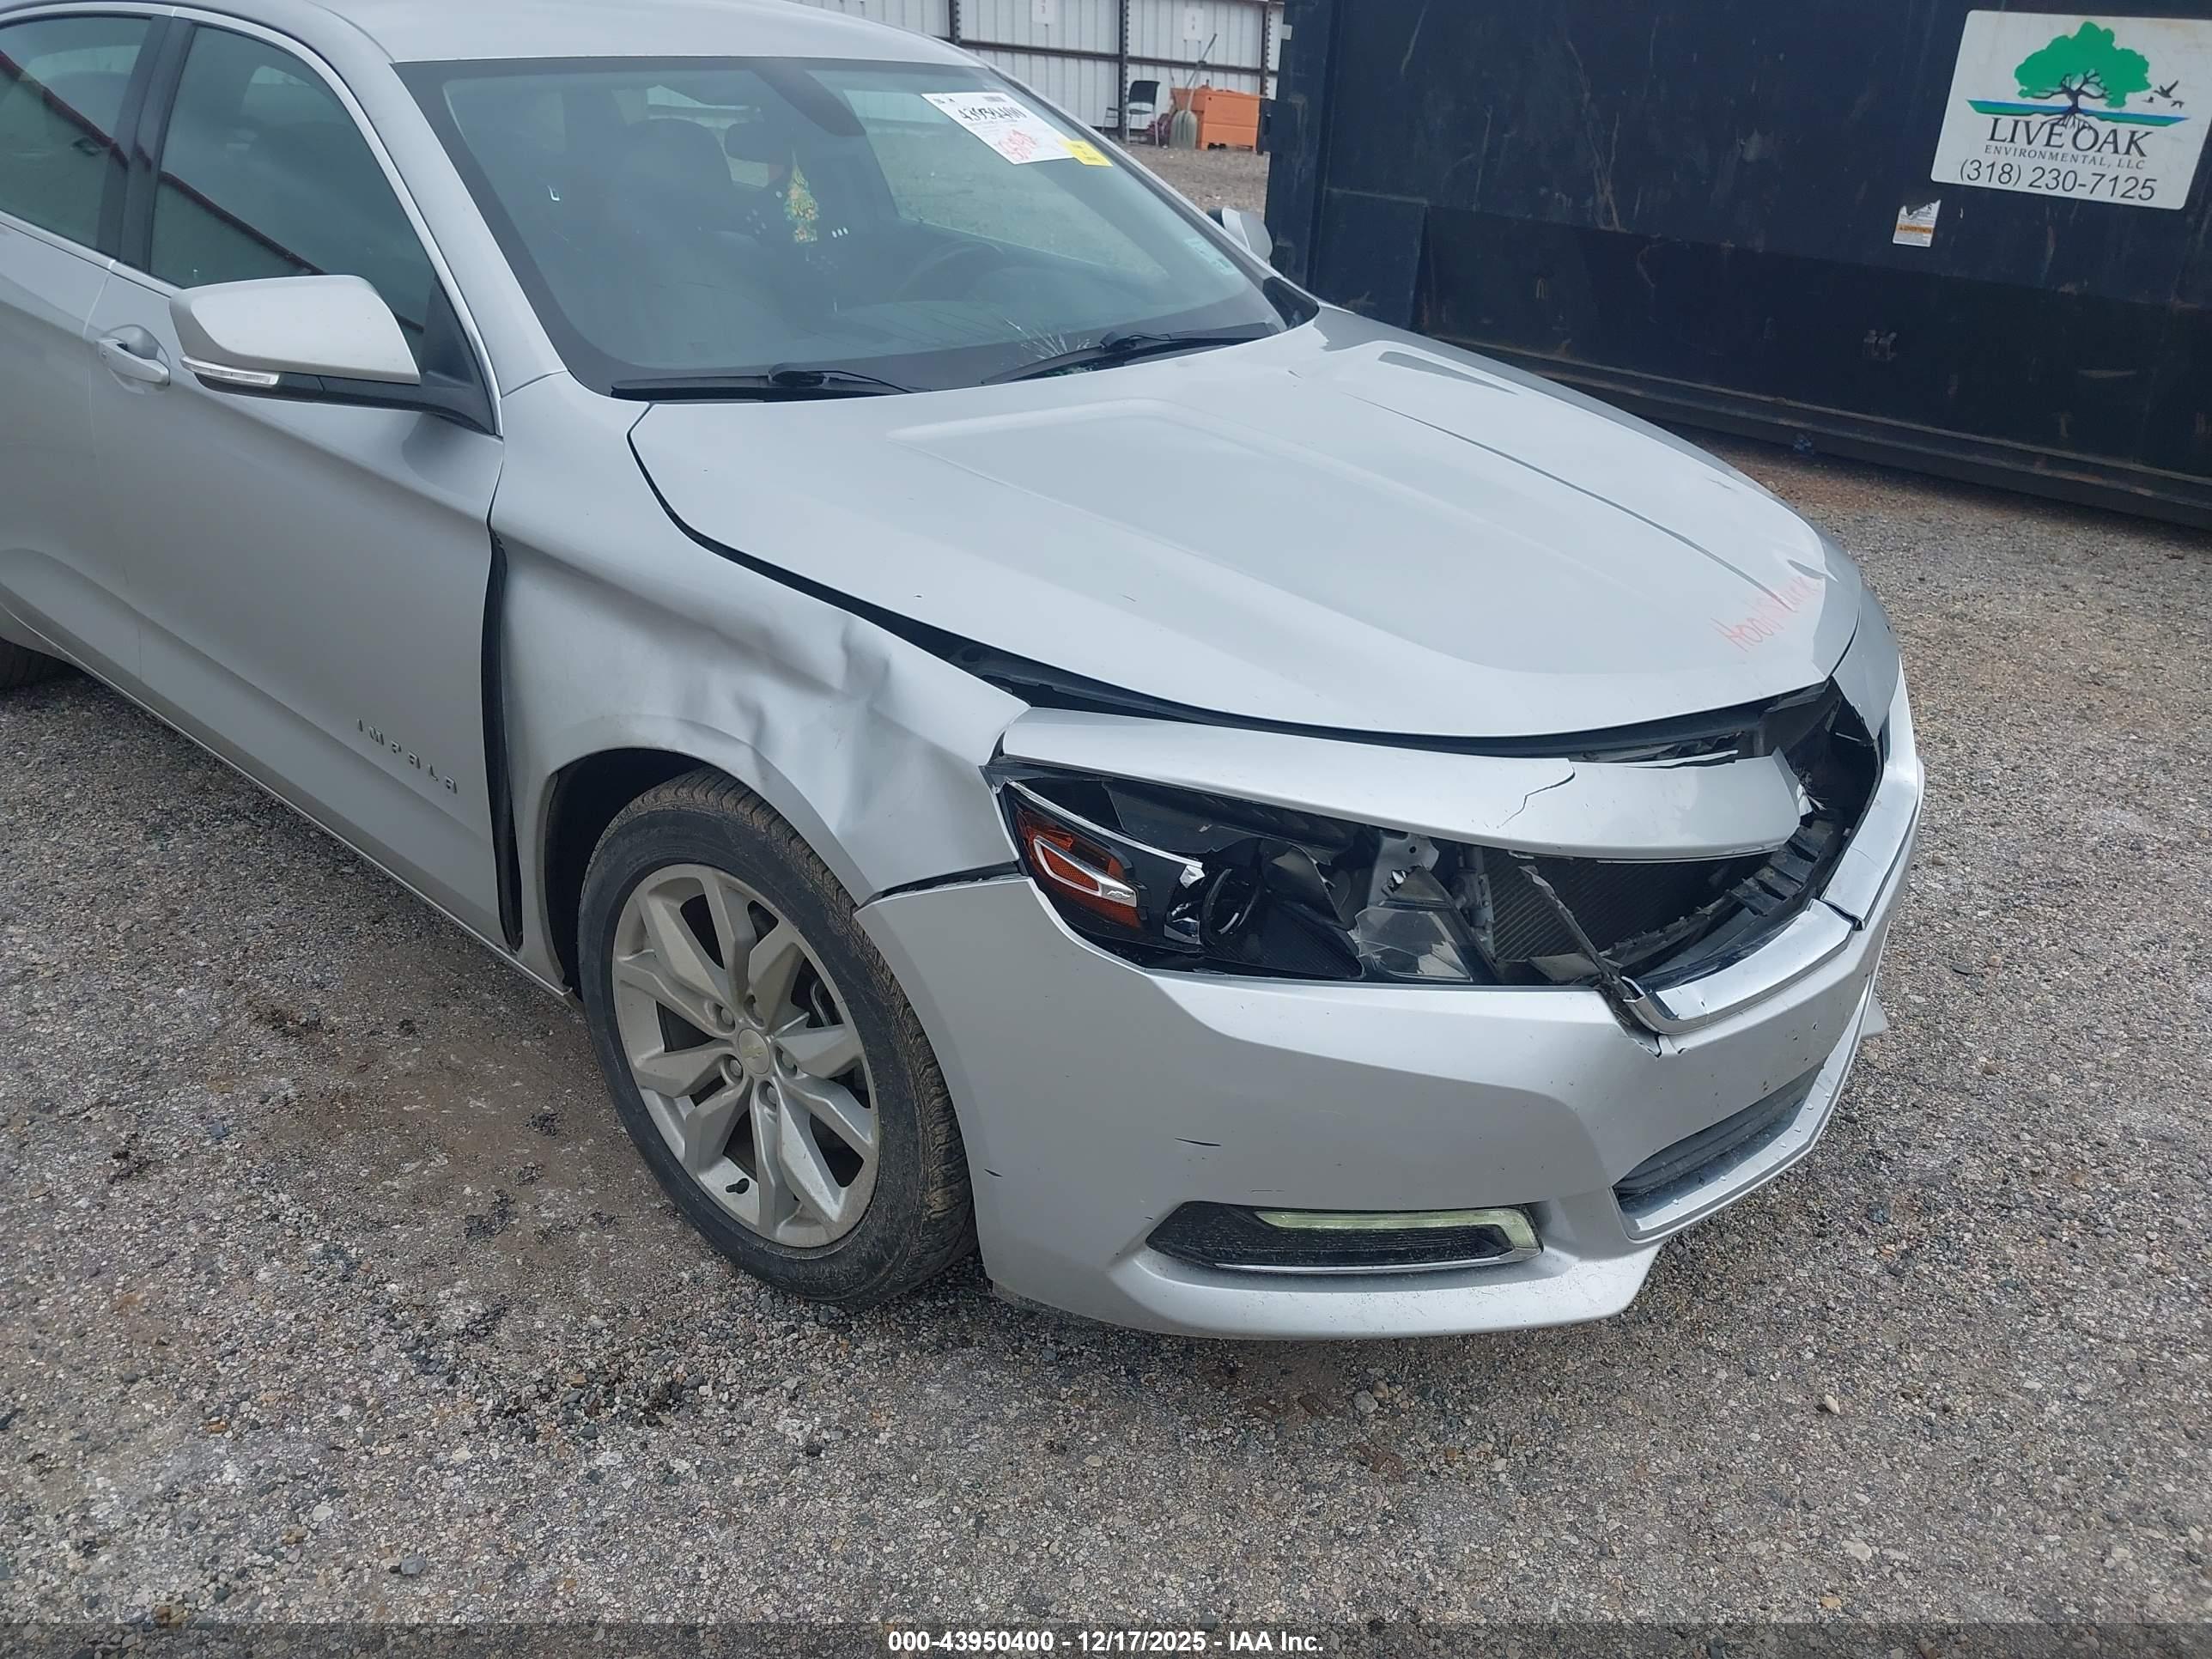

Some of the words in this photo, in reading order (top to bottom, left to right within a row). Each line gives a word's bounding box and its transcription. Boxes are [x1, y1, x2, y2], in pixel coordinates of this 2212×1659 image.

[1984, 144, 2112, 168] ENVIRONMENTAL,
[2117, 157, 2146, 170] LLC
[1987, 117, 2064, 149] LIVE
[2071, 126, 2154, 158] OAK
[1960, 158, 2022, 187] (318)
[2027, 166, 2158, 202] 230-7125
